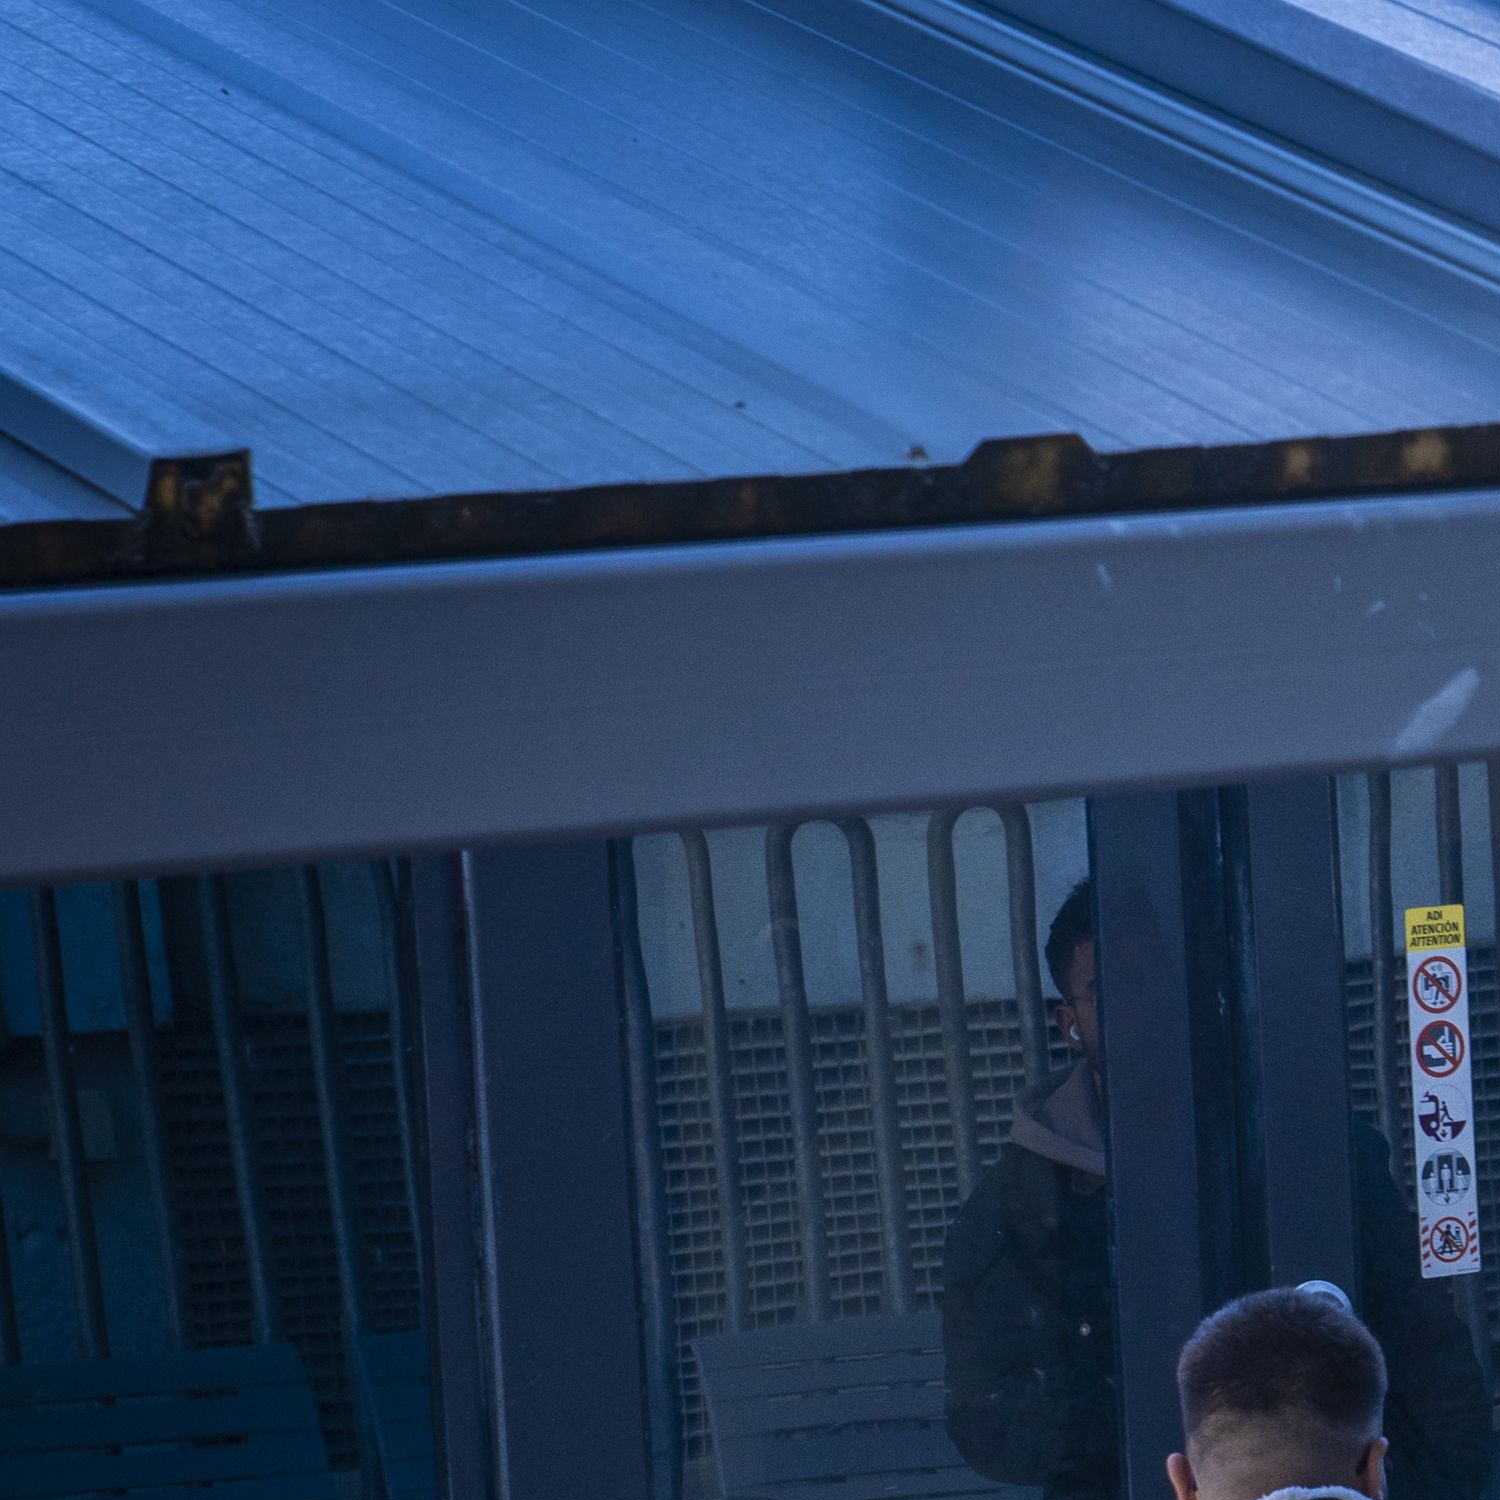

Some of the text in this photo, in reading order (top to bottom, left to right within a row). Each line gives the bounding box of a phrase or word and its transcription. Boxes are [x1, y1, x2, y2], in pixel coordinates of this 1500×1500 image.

[1427, 910, 1443, 921] ADI
[1411, 921, 1459, 935] ATENCIÓN
[1409, 933, 1461, 947] ATTENTION
